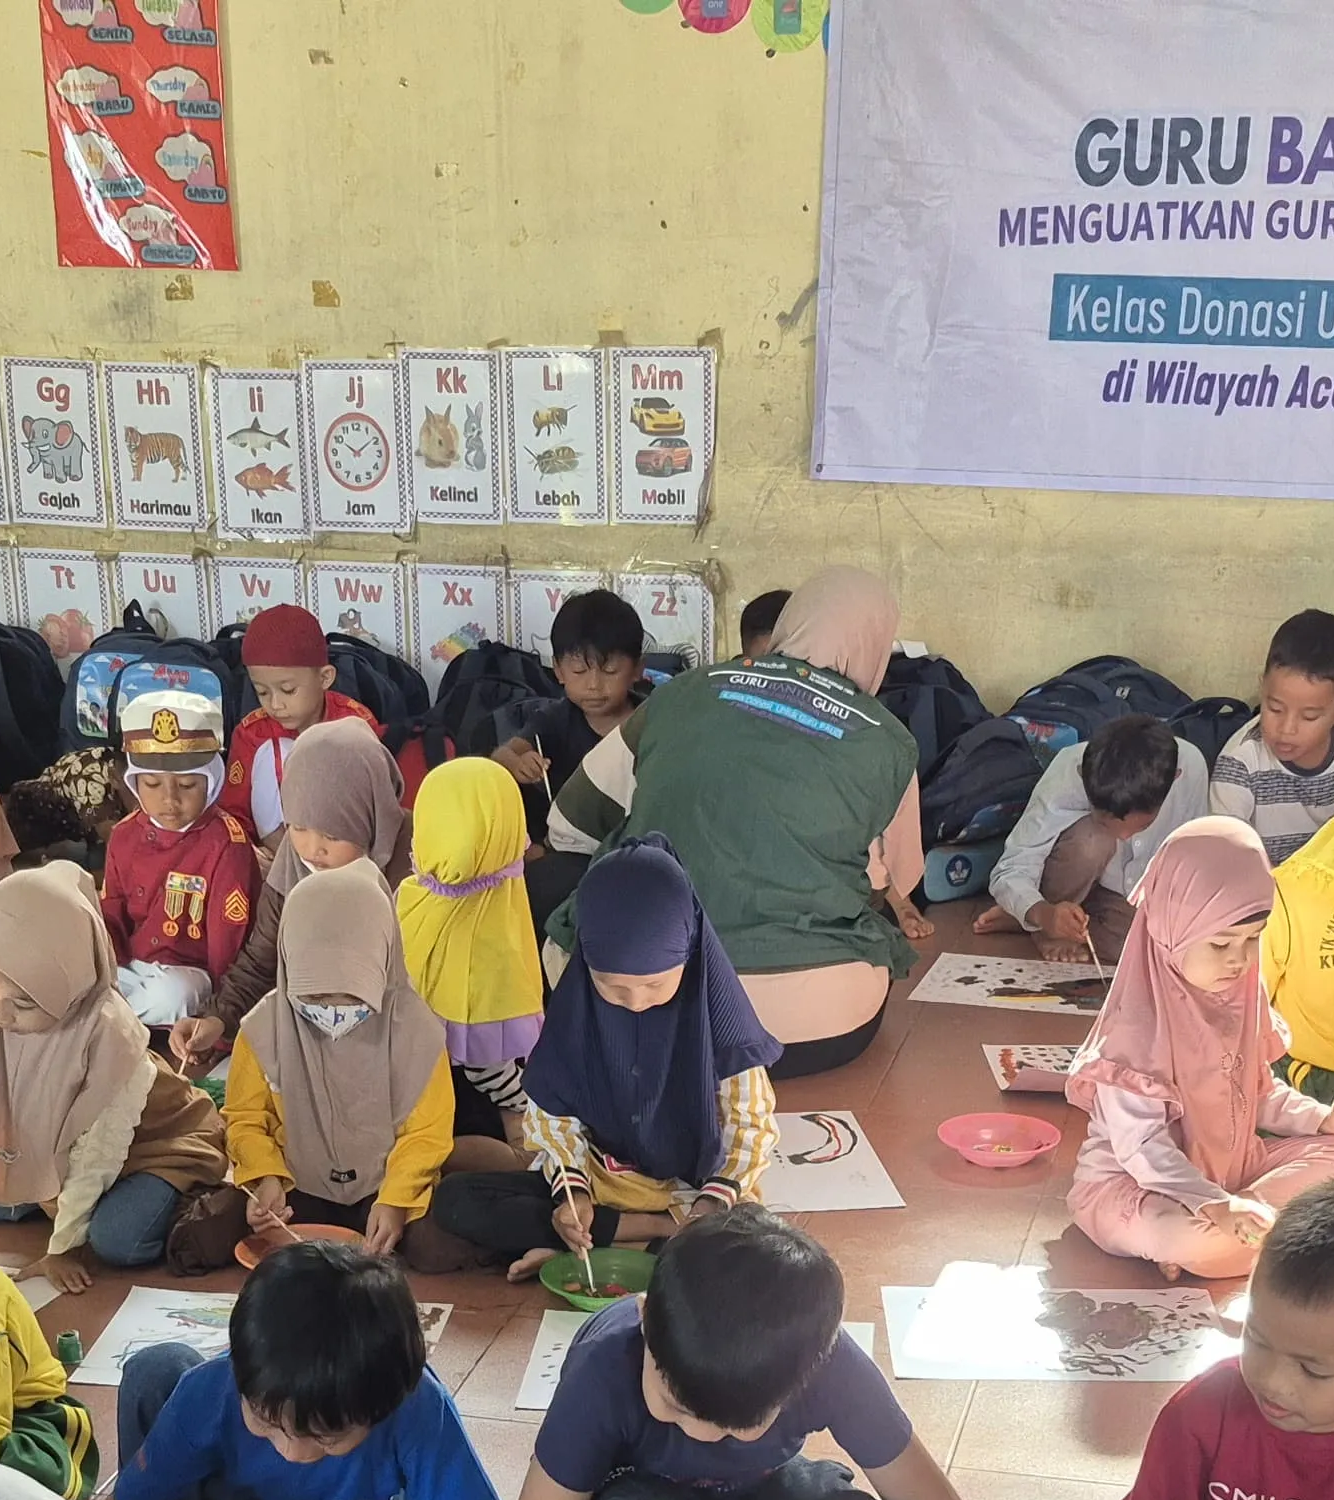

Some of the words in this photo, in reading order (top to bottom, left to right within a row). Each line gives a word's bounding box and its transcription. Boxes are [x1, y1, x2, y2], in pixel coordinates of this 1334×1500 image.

[92, 28, 128, 40] SENIN
[167, 30, 213, 43] SELASA
[96, 100, 129, 113] RABU
[179, 102, 217, 114] KAMIS
[1075, 116, 1251, 187] GURU
[998, 200, 1255, 247] MENGUATKAN
[1067, 284, 1166, 334] Kelas
[1178, 287, 1306, 339] Donasi
[436, 367, 468, 394] Kk
[631, 363, 684, 391] Mm
[36, 376, 70, 413] Gg
[136, 378, 170, 406] Hh
[345, 376, 364, 409] Jj
[1102, 358, 1138, 403] di
[1145, 360, 1280, 416] Wilayah
[248, 386, 264, 413] Ii
[351, 422, 361, 431] 12
[334, 435, 344, 444] 10
[372, 436, 379, 445] 2
[331, 448, 338, 457] 9
[376, 449, 383, 458] 3
[344, 470, 351, 479] 7
[365, 471, 372, 480] 5
[372, 462, 379, 470] 4
[354, 474, 362, 483] 6
[38, 491, 80, 510] Gajah
[429, 486, 479, 504] Kelinci
[535, 490, 581, 507] Lebah
[641, 488, 686, 506] Mobil
[130, 499, 191, 517] Harimau
[251, 508, 283, 525] Ikan
[345, 500, 375, 517] Jam
[50, 565, 75, 590] Tt
[143, 568, 176, 594] Uu
[239, 573, 272, 598] Vv
[334, 577, 383, 603] Ww
[442, 581, 474, 607] Xx
[545, 587, 569, 614] Y
[651, 591, 679, 617] Zz
[152, 664, 190, 687] Ayo
[729, 674, 767, 689] GURU
[812, 696, 850, 720] GURU
